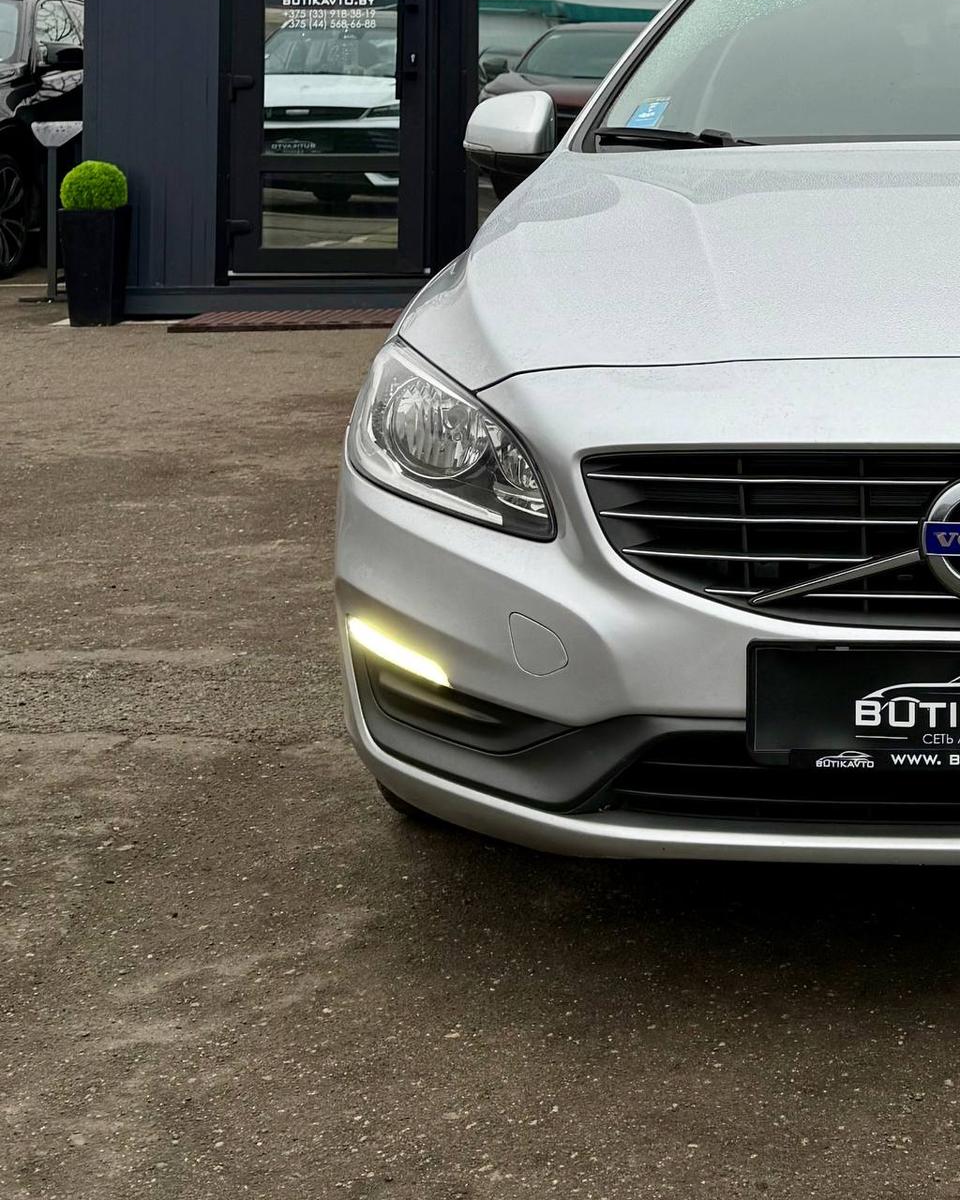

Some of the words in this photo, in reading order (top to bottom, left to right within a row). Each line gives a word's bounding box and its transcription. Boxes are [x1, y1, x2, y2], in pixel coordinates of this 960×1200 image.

[283, 10, 306, 19] +375
[309, 10, 327, 20] (33)
[309, 19, 327, 30] (44)
[922, 733, 954, 745] СЕТЬ
[815, 760, 875, 768] BUTIKAVTO
[890, 754, 942, 766] WWW.
